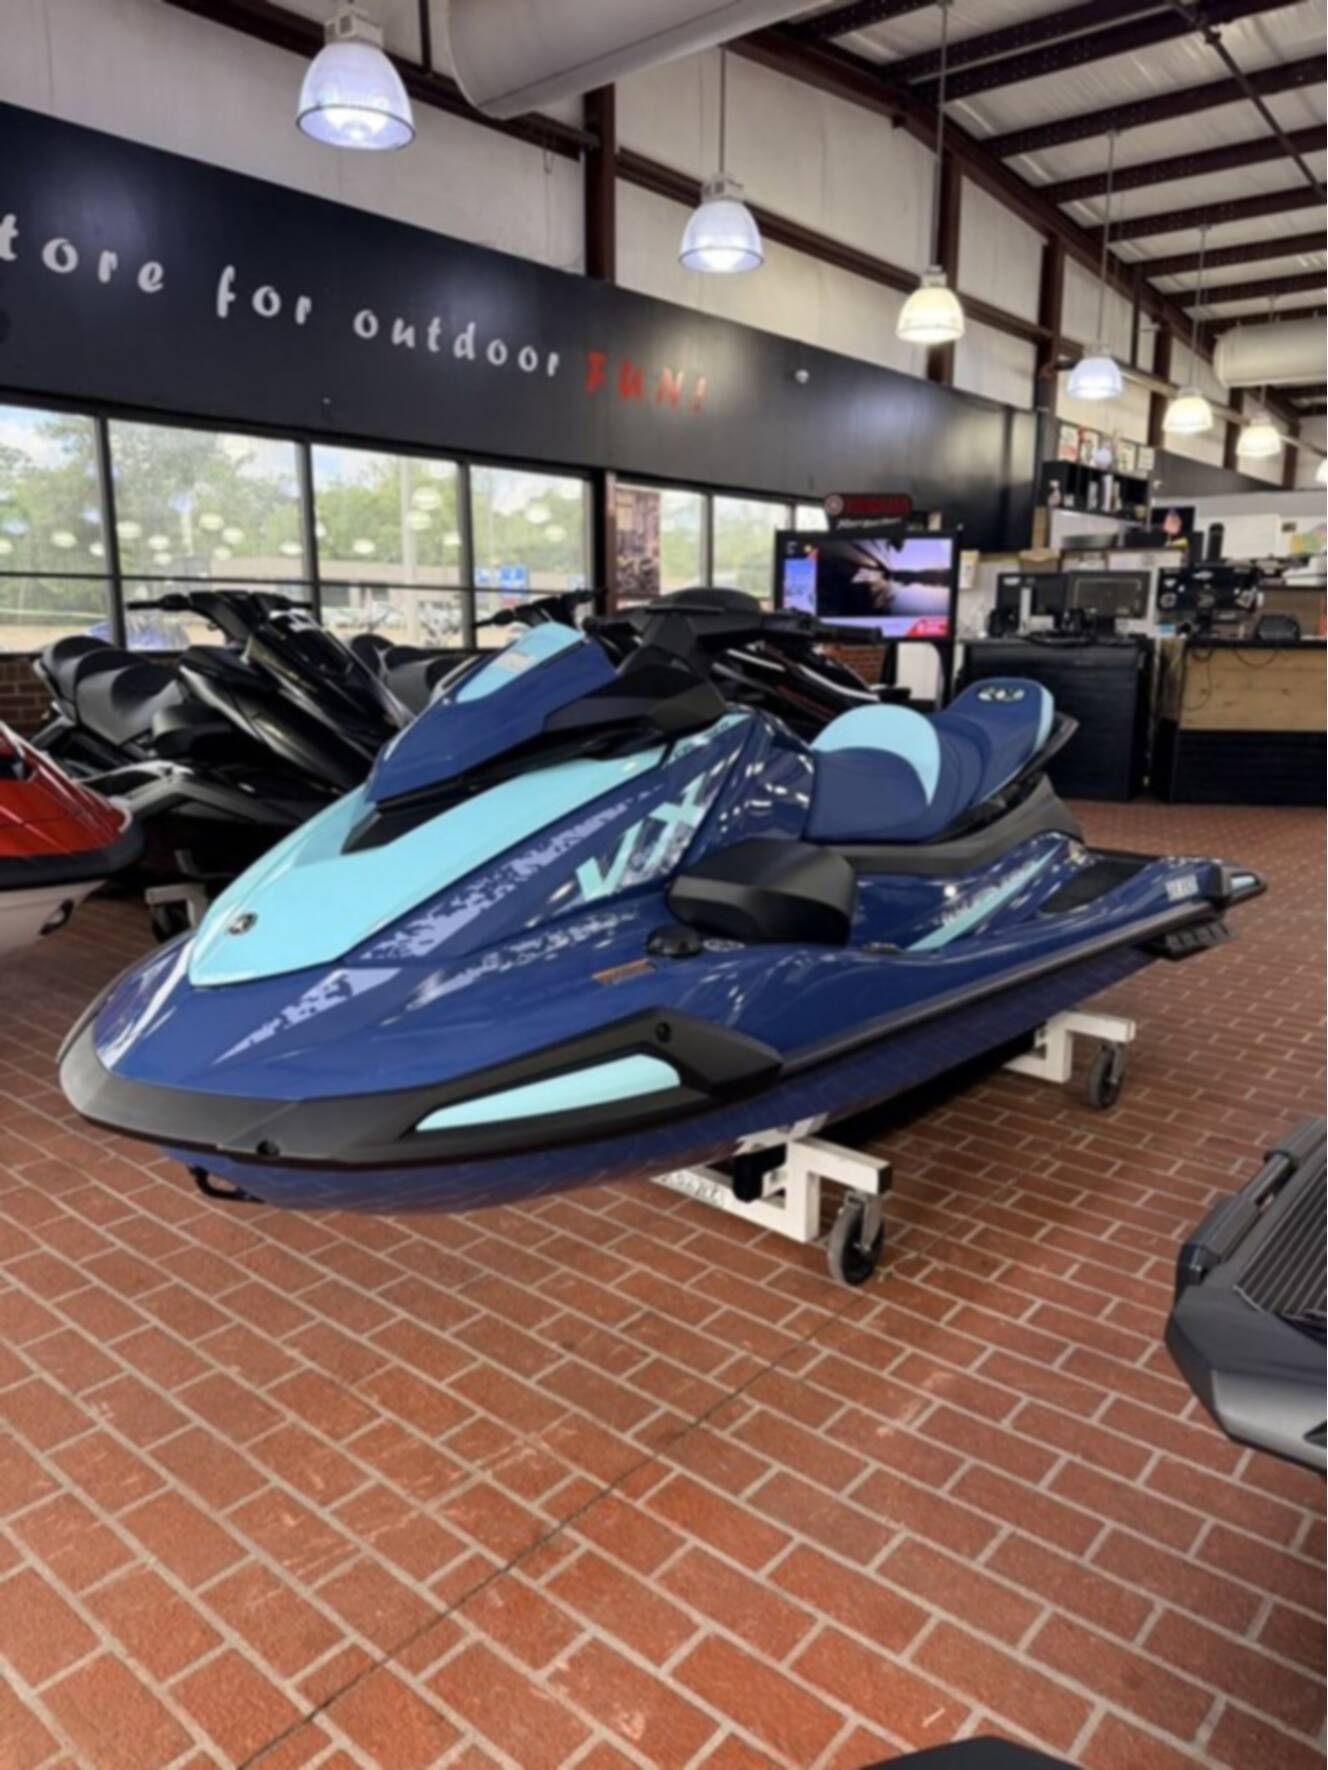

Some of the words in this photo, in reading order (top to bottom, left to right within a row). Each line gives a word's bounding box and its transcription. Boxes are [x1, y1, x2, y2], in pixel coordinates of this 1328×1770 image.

[0, 213, 164, 293] tore
[216, 264, 312, 325] for
[353, 309, 559, 376] outdoor
